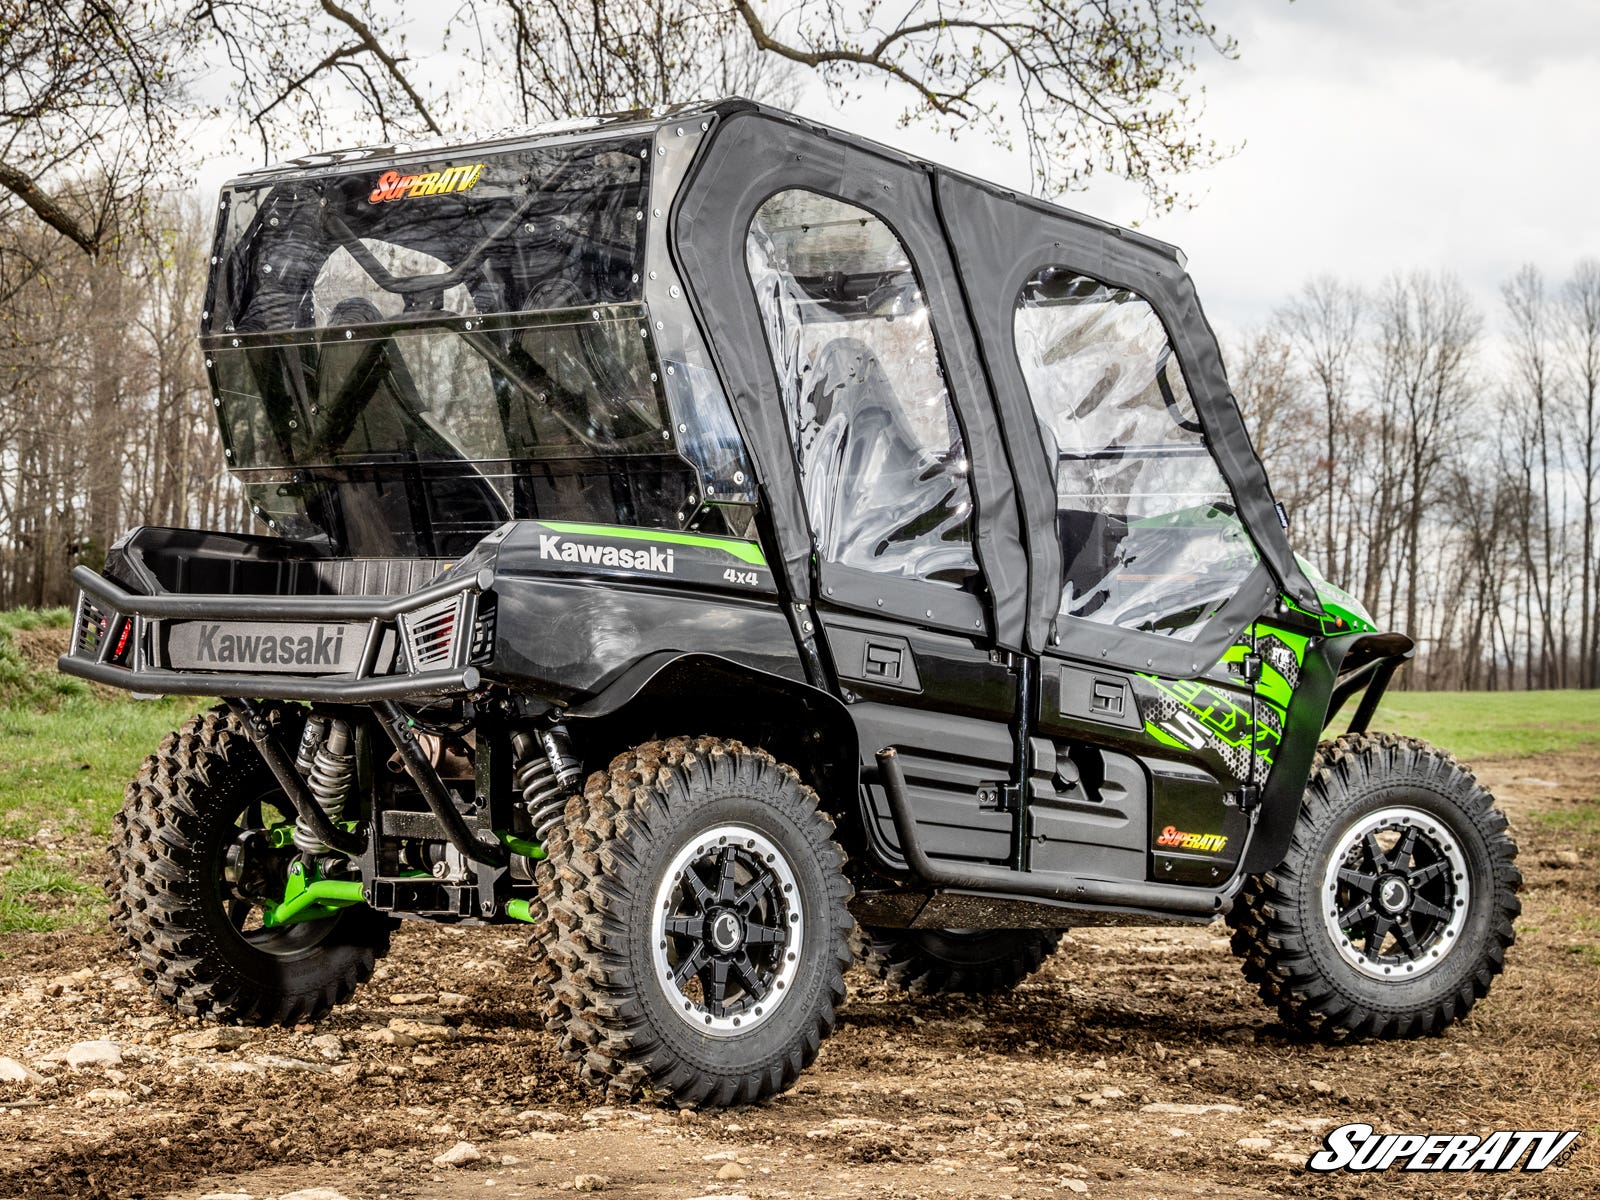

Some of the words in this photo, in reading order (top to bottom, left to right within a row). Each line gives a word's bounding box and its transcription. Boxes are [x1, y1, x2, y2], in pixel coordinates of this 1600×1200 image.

[368, 164, 482, 203] SUPERATV
[538, 534, 674, 573] Kawasaki
[723, 568, 759, 586] 4x4
[196, 624, 345, 665] Kawasaki
[1156, 825, 1228, 851] SUPERATV
